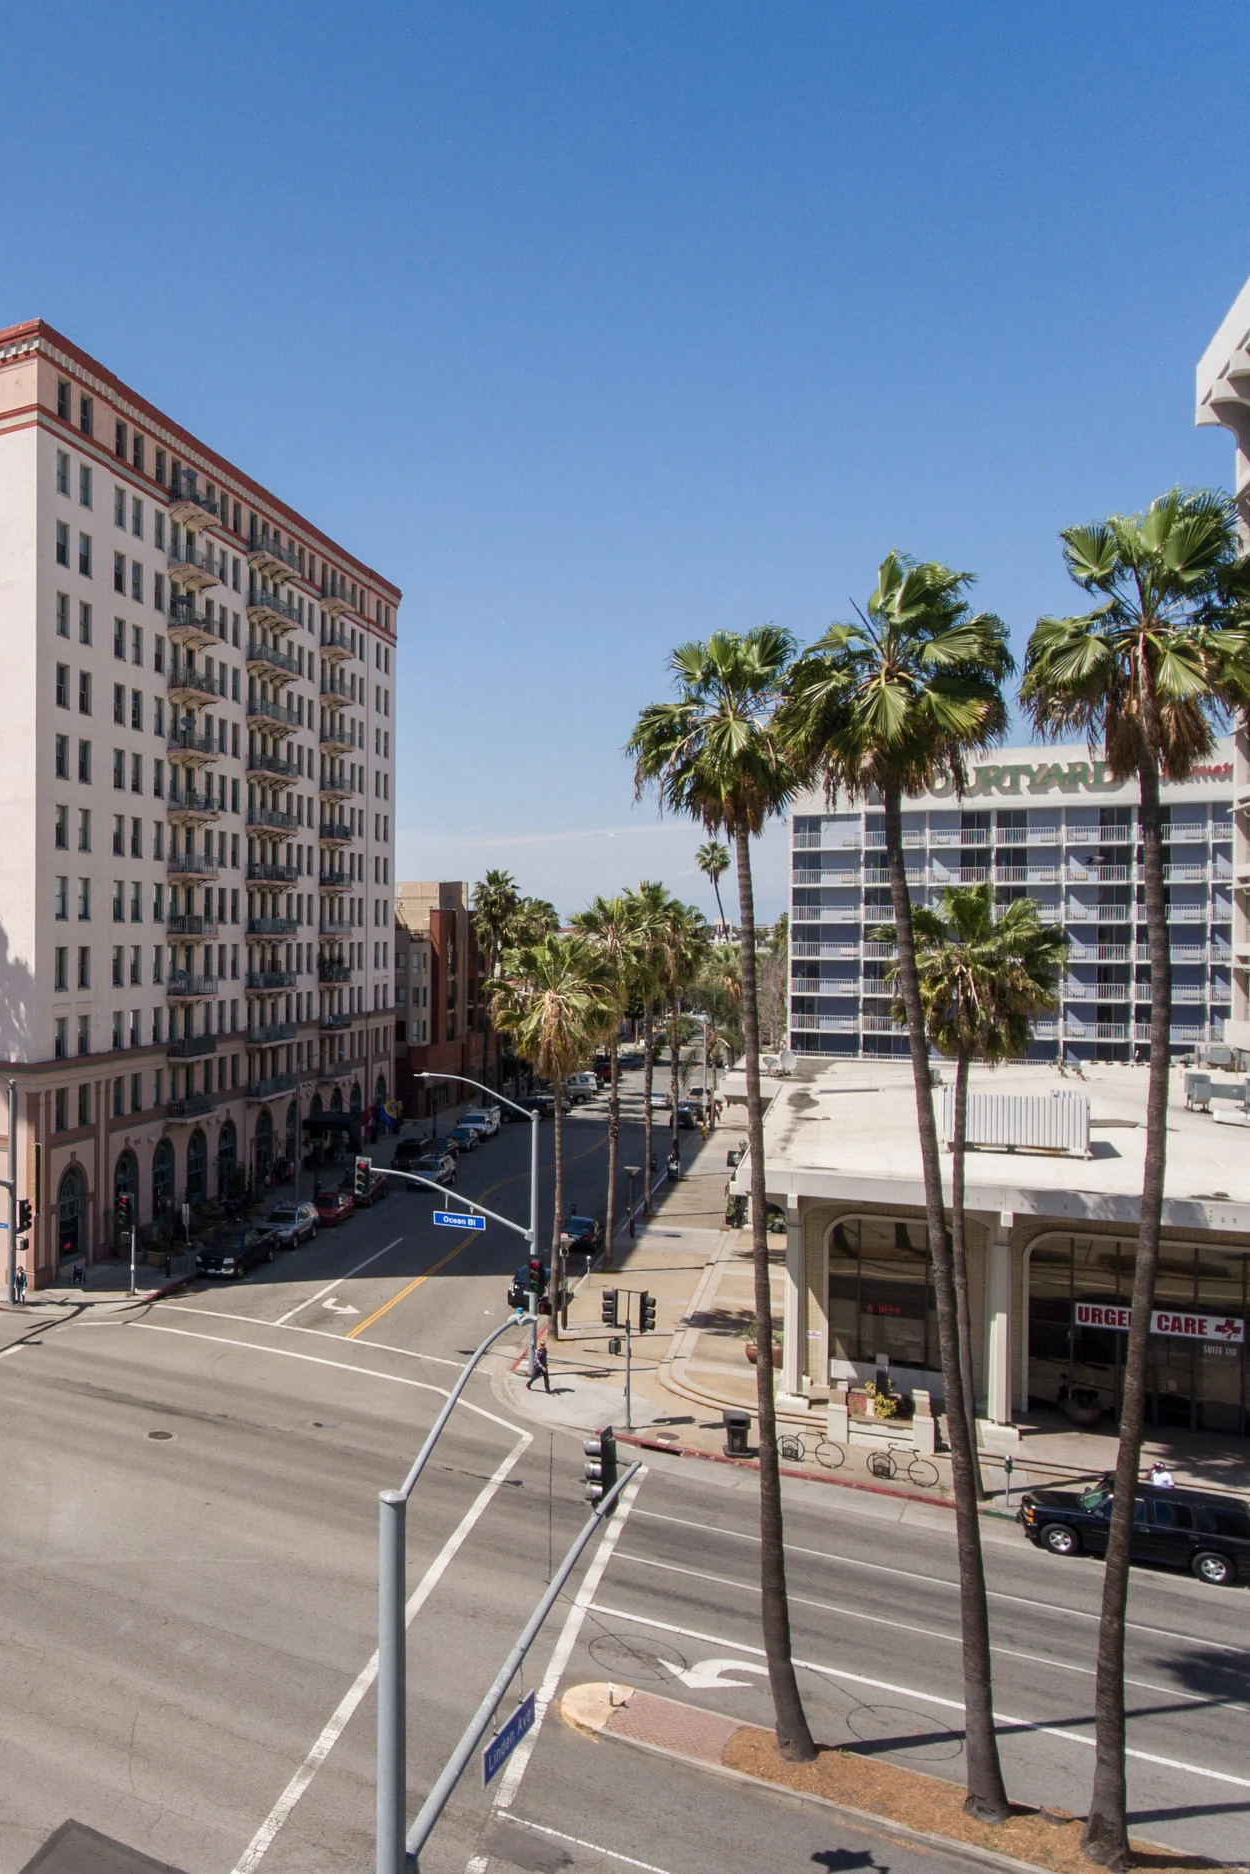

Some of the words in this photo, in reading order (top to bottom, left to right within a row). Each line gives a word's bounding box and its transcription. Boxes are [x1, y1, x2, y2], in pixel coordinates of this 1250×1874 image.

[902, 760, 1122, 795] OURTYARD
[443, 1216, 466, 1225] Ocean
[1077, 1306, 1133, 1328] URGE
[1157, 1314, 1207, 1336] CARE
[1203, 1345, 1223, 1356] SUITE
[1225, 1347, 1237, 1357] 110
[488, 1731, 515, 1772] Linden
[517, 1709, 532, 1735] Ave
